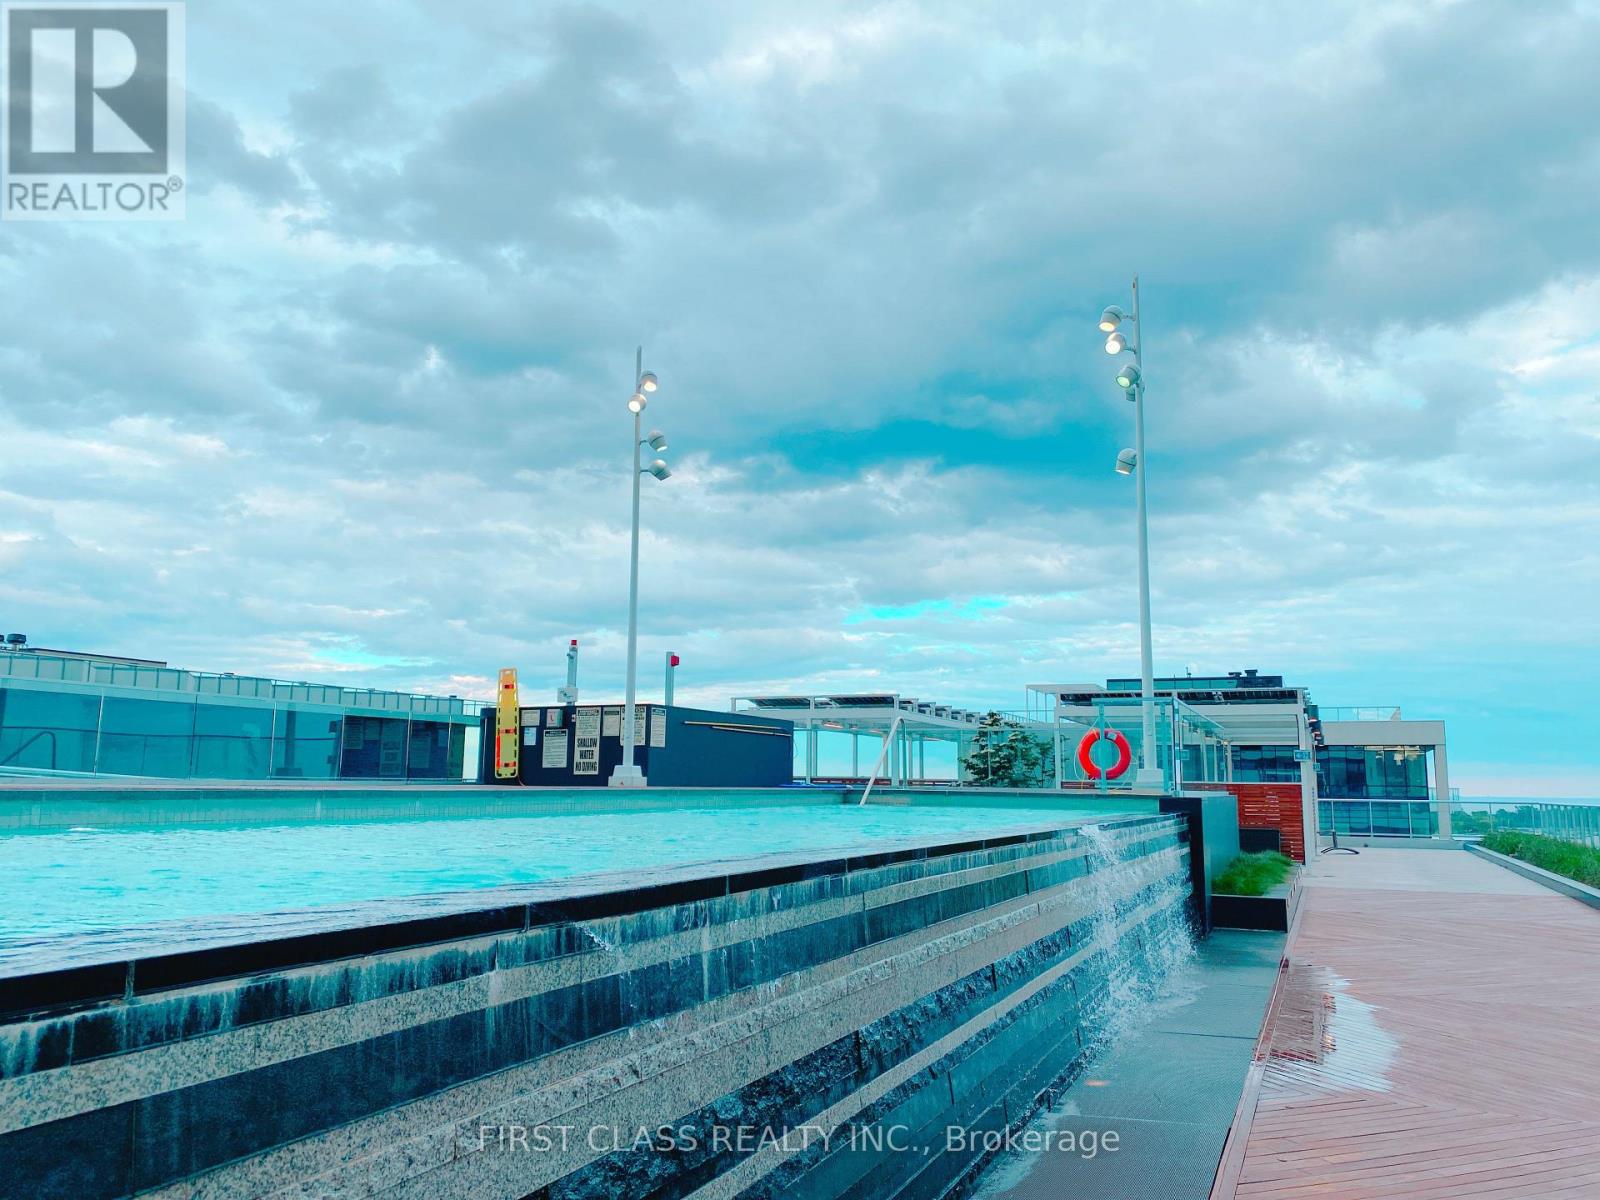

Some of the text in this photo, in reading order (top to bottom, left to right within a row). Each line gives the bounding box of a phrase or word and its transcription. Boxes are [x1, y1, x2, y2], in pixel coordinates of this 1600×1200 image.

[577, 737, 598, 748] SHALLOW
[579, 749, 594, 760] WATER
[575, 761, 598, 772] NO DIVING
